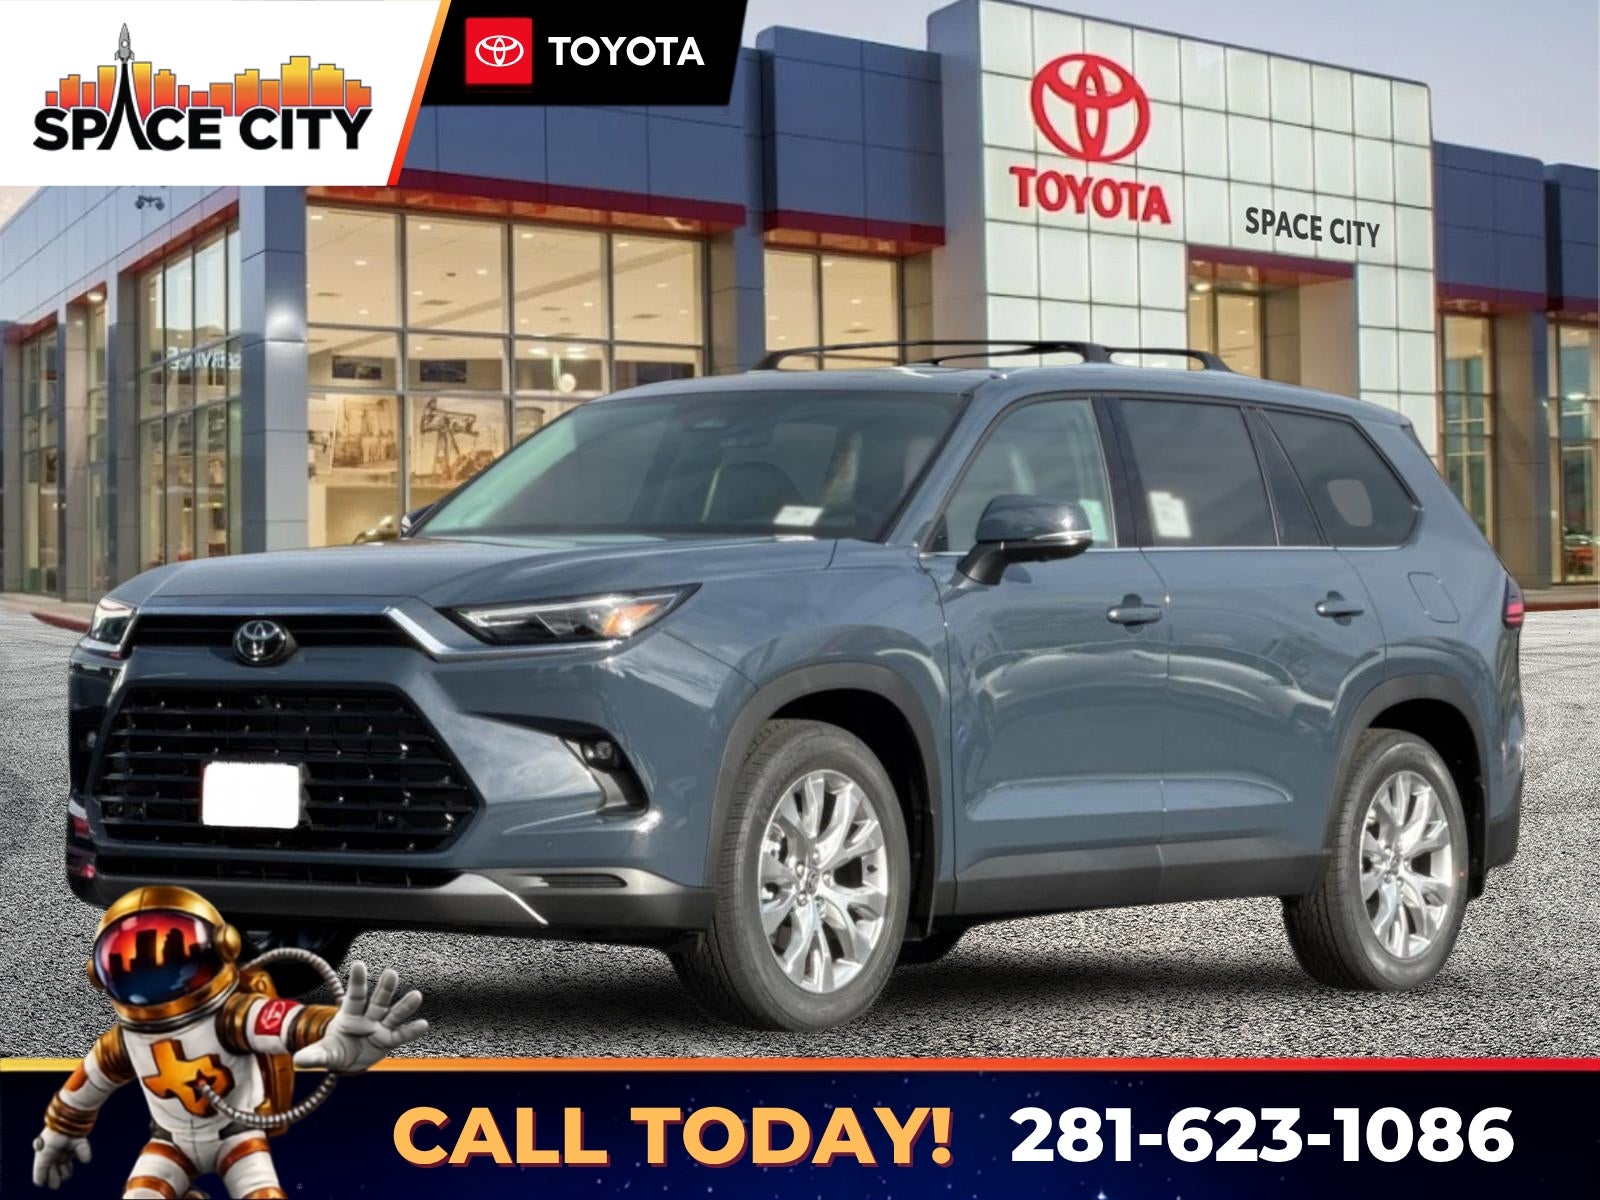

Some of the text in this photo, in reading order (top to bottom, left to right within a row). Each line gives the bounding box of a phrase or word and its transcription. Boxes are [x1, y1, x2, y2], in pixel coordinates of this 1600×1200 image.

[1009, 166, 1171, 224] TOYOTA
[1245, 206, 1381, 248] SPACE CITY
